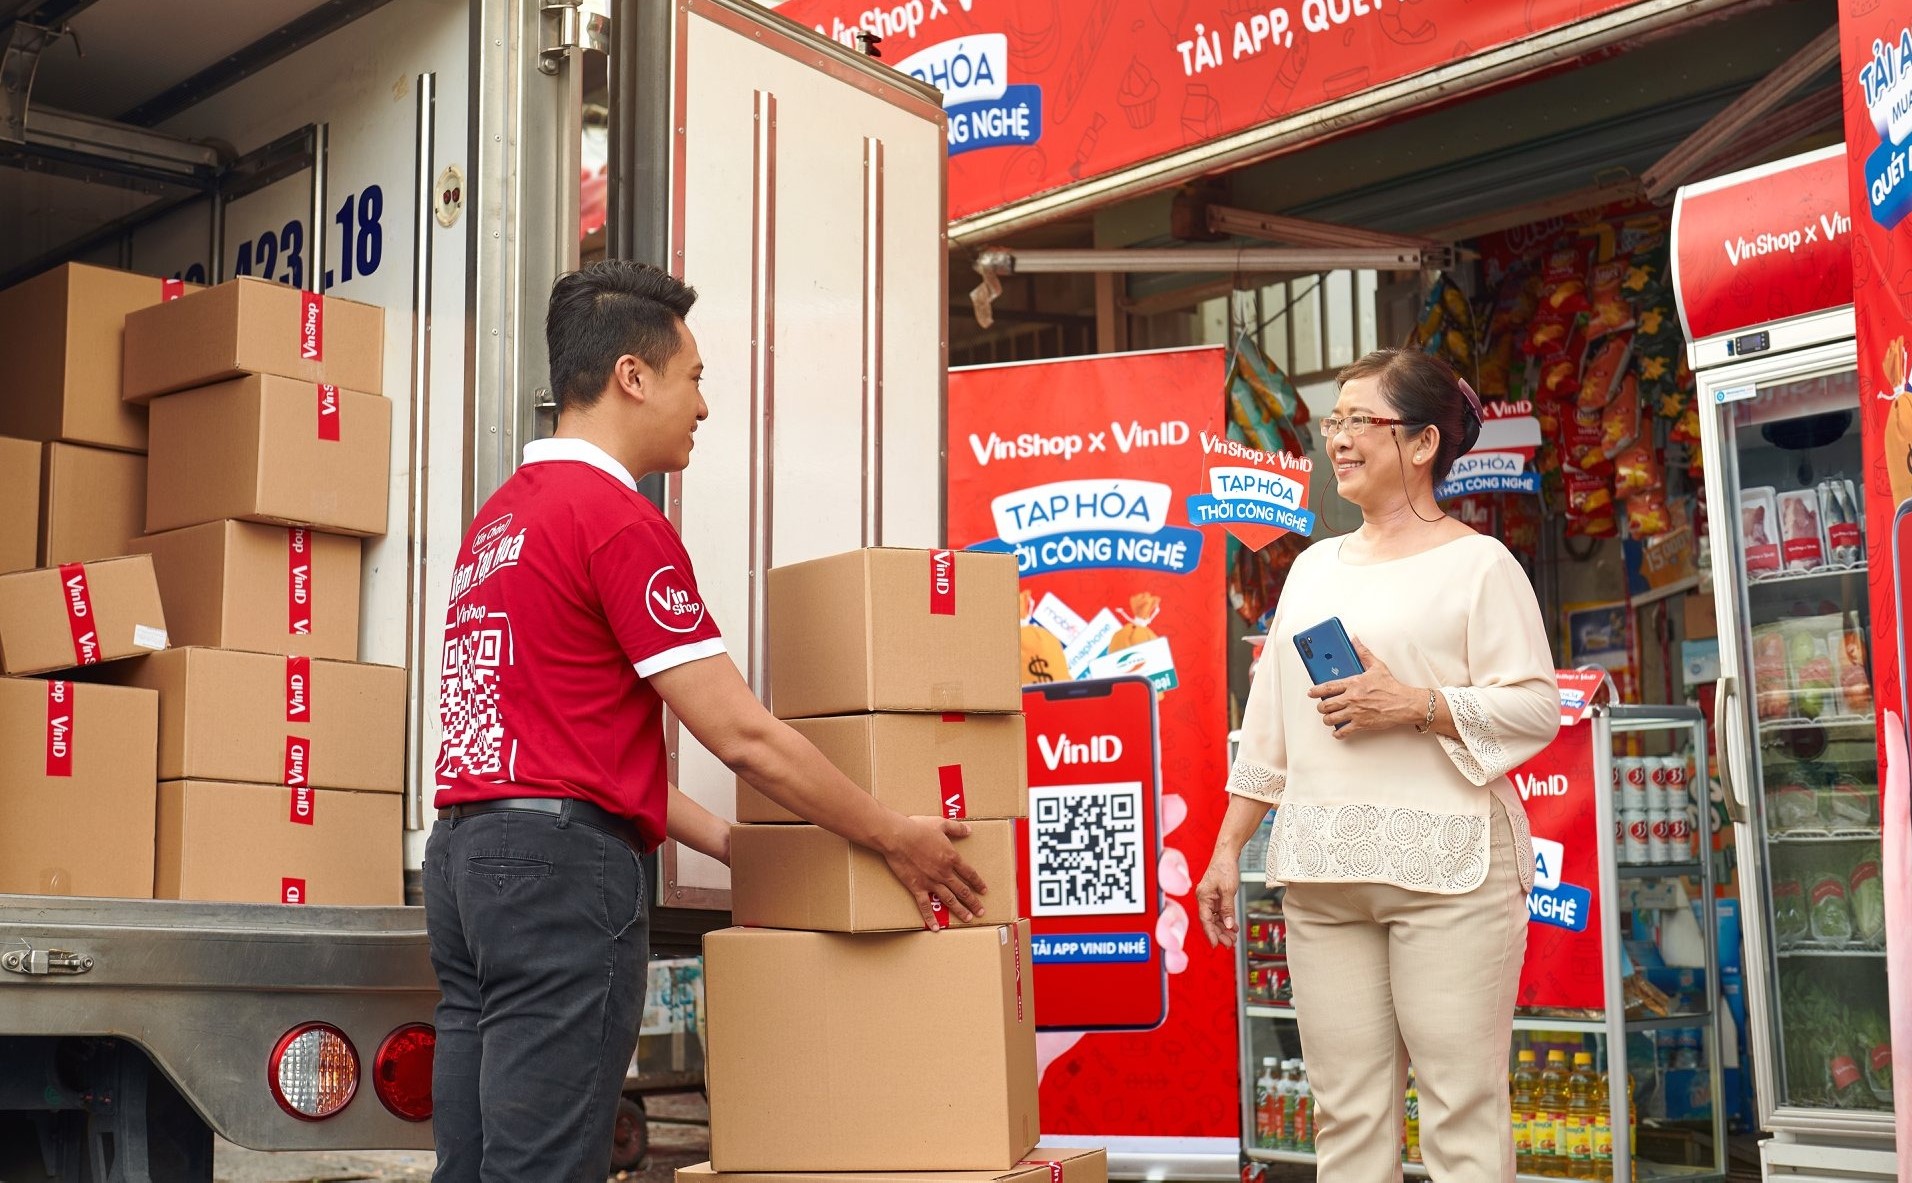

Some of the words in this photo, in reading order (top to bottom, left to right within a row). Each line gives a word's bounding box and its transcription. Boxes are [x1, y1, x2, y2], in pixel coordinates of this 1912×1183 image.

[1176, 23, 1223, 76] TẢI
[1232, 7, 1294, 60] APP,
[1301, 0, 1383, 33] QU
[1861, 40, 1896, 106] TẢI
[972, 102, 1031, 140] NGHỆ
[1871, 151, 1906, 206] QUÉT
[1724, 228, 1801, 267] VinShop
[1805, 225, 1818, 244] x
[302, 302, 319, 359] VinShop
[1491, 400, 1533, 417] VinID
[968, 432, 1083, 466] VinShop
[1088, 432, 1106, 453] x
[1111, 420, 1190, 454] VinID
[1200, 431, 1264, 466] VinShop
[1266, 452, 1276, 466] x
[1279, 450, 1313, 473] VinID
[1480, 454, 1516, 472] HÓA
[1217, 475, 1254, 493] TẠP
[1258, 477, 1295, 504] HÓA
[1465, 476, 1499, 492] CÔNG
[1501, 477, 1534, 492] NGHỆ
[1005, 493, 1069, 531] TẠP
[1077, 484, 1151, 523] HÓA
[1198, 500, 1234, 521] THỜI
[1236, 500, 1274, 521] CÔNG
[1276, 510, 1308, 534] NGHỆ
[934, 550, 951, 595] VinID
[1041, 536, 1111, 567] CÔNG
[1117, 537, 1188, 570] NGHỆ
[66, 575, 87, 618] VinID
[292, 564, 308, 605] VinID
[651, 585, 689, 611] Vin
[672, 602, 700, 616] Shop
[289, 674, 306, 715] VinID
[51, 716, 69, 758] VinID
[1036, 733, 1124, 770] VinID
[287, 745, 304, 786] VinID
[1515, 773, 1568, 801] VinID
[1526, 893, 1577, 926] NGHỆ
[1032, 937, 1051, 956] TẢI
[1053, 942, 1076, 955] APP
[1077, 942, 1116, 955] VINID
[1118, 937, 1146, 954] NHÉ
